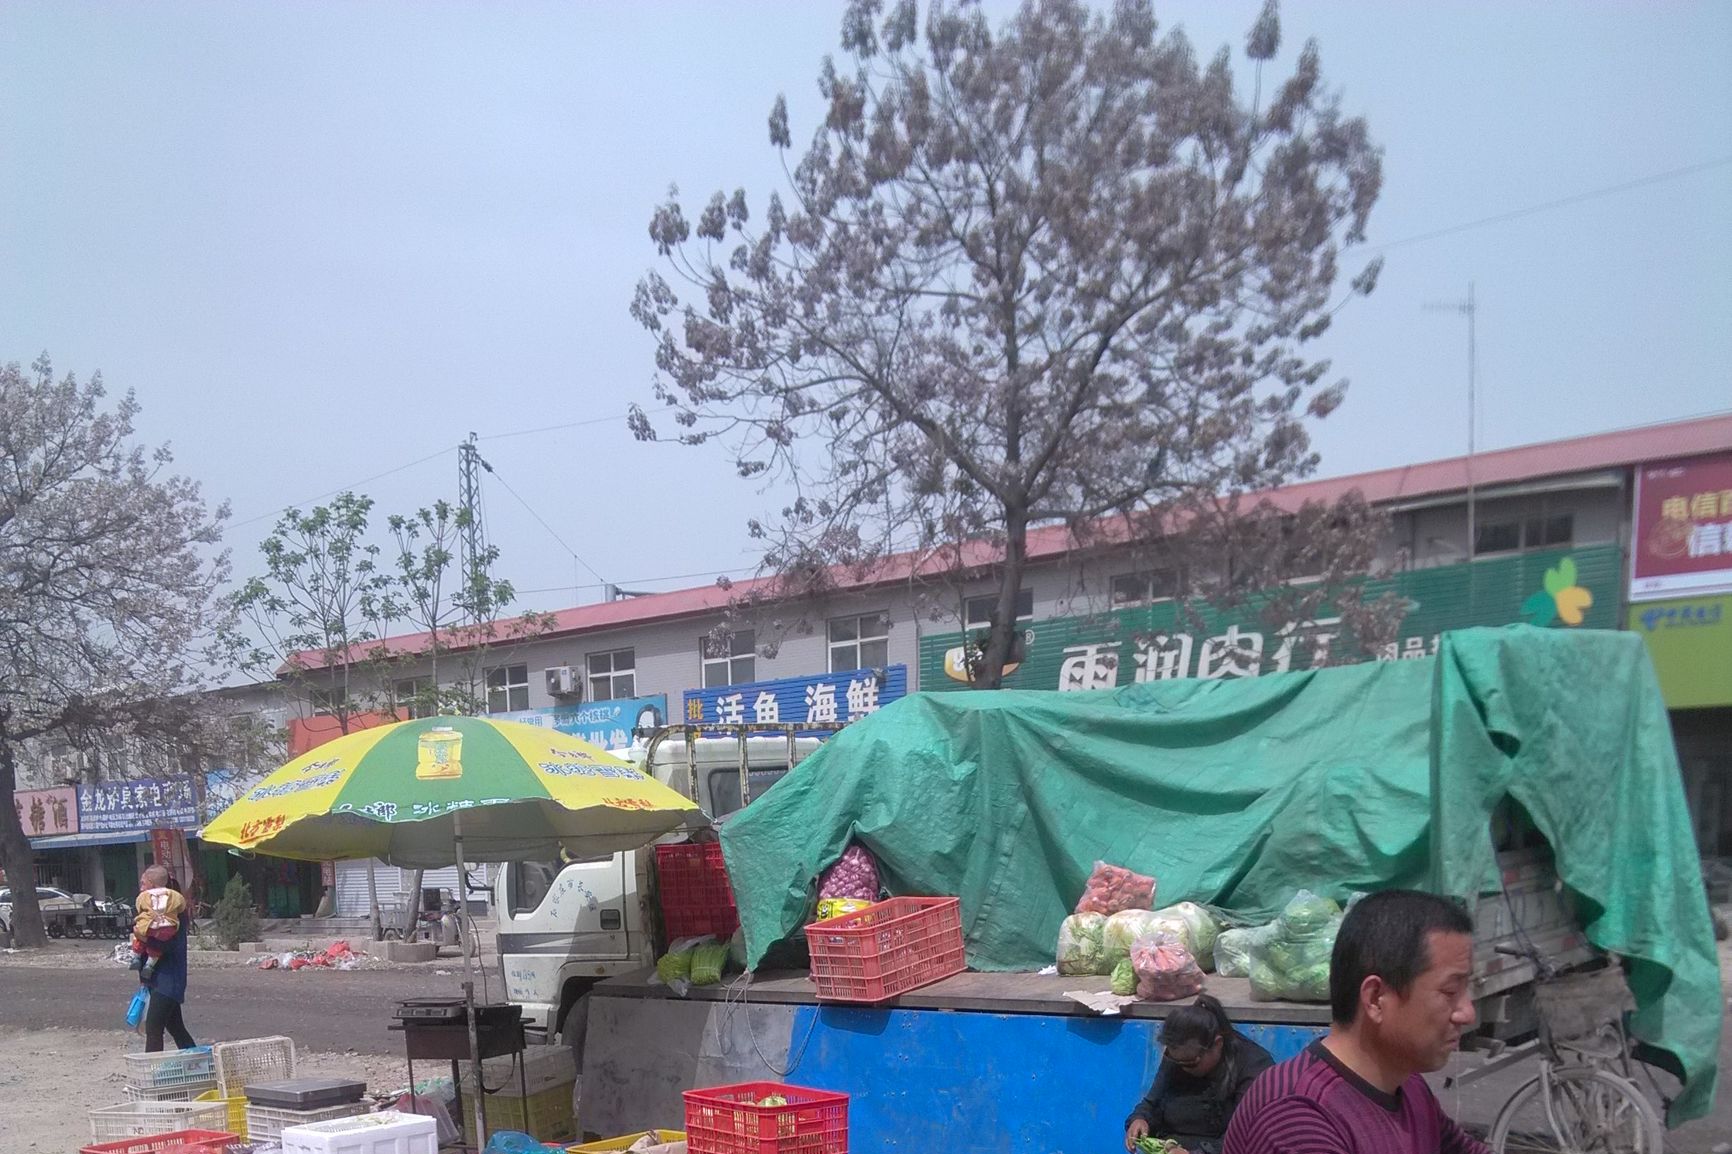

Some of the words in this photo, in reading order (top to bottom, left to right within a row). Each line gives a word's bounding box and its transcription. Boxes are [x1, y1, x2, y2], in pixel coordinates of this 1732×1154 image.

[1689, 521, 1732, 559] 信
[1059, 617, 1342, 692] 雨润肉行
[716, 691, 779, 736] 活鱼
[805, 677, 881, 723] 海鲜
